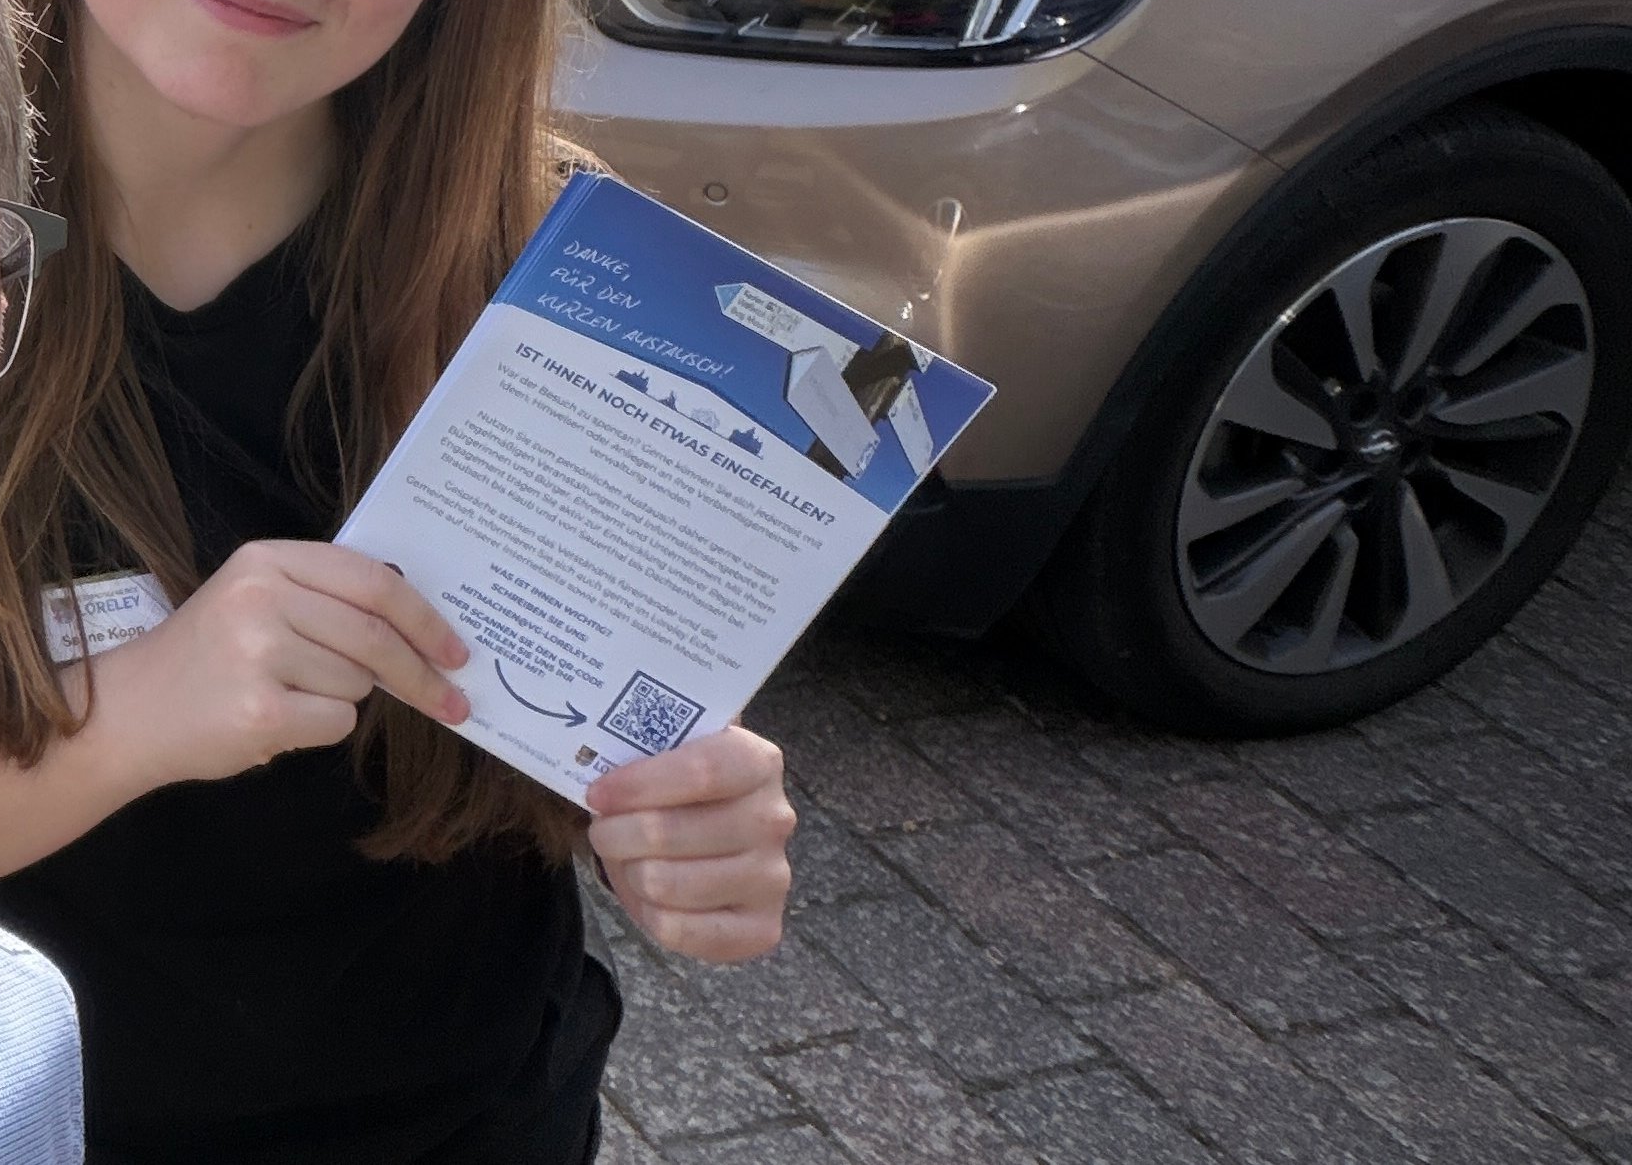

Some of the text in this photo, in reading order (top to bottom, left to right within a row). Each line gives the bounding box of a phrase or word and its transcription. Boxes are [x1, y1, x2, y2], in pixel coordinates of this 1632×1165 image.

[563, 238, 630, 281] DANKE,
[549, 266, 641, 309] FÜR DEN
[536, 291, 734, 379] KURZEN AUSTAUSCH!
[495, 362, 520, 380] War
[518, 374, 538, 390] der
[537, 385, 578, 412] Besuch
[640, 442, 675, 467] Gerne
[515, 342, 836, 527] IST IHNEN NOCH ETWAS EINGEFALLEN?
[584, 427, 610, 446] oder
[437, 436, 506, 480] Engagement
[503, 473, 541, 500] tragen
[584, 519, 601, 532] zur
[476, 410, 515, 436] Nutzen
[514, 431, 532, 445] Sie
[554, 454, 623, 498] persönlichen
[622, 491, 678, 527] Austausch
[511, 461, 535, 478] und
[440, 451, 491, 485] Braubach
[489, 479, 507, 494] bis
[534, 505, 557, 523] und
[556, 519, 577, 534] von
[619, 506, 644, 524] und
[82, 595, 140, 616] ORELEY
[488, 563, 514, 581] WAS
[513, 577, 530, 590] IST
[529, 586, 563, 609] IHNEN
[489, 582, 548, 619] SCHREIBEN
[546, 614, 564, 628] SIE
[440, 591, 469, 612] ODER
[468, 608, 517, 639] SCANNEN
[517, 635, 534, 649] SIE
[533, 645, 557, 662] DEN
[457, 612, 575, 683] UND TEILEN SIE UNS IHR
[474, 633, 524, 666] ANLIEGEN
